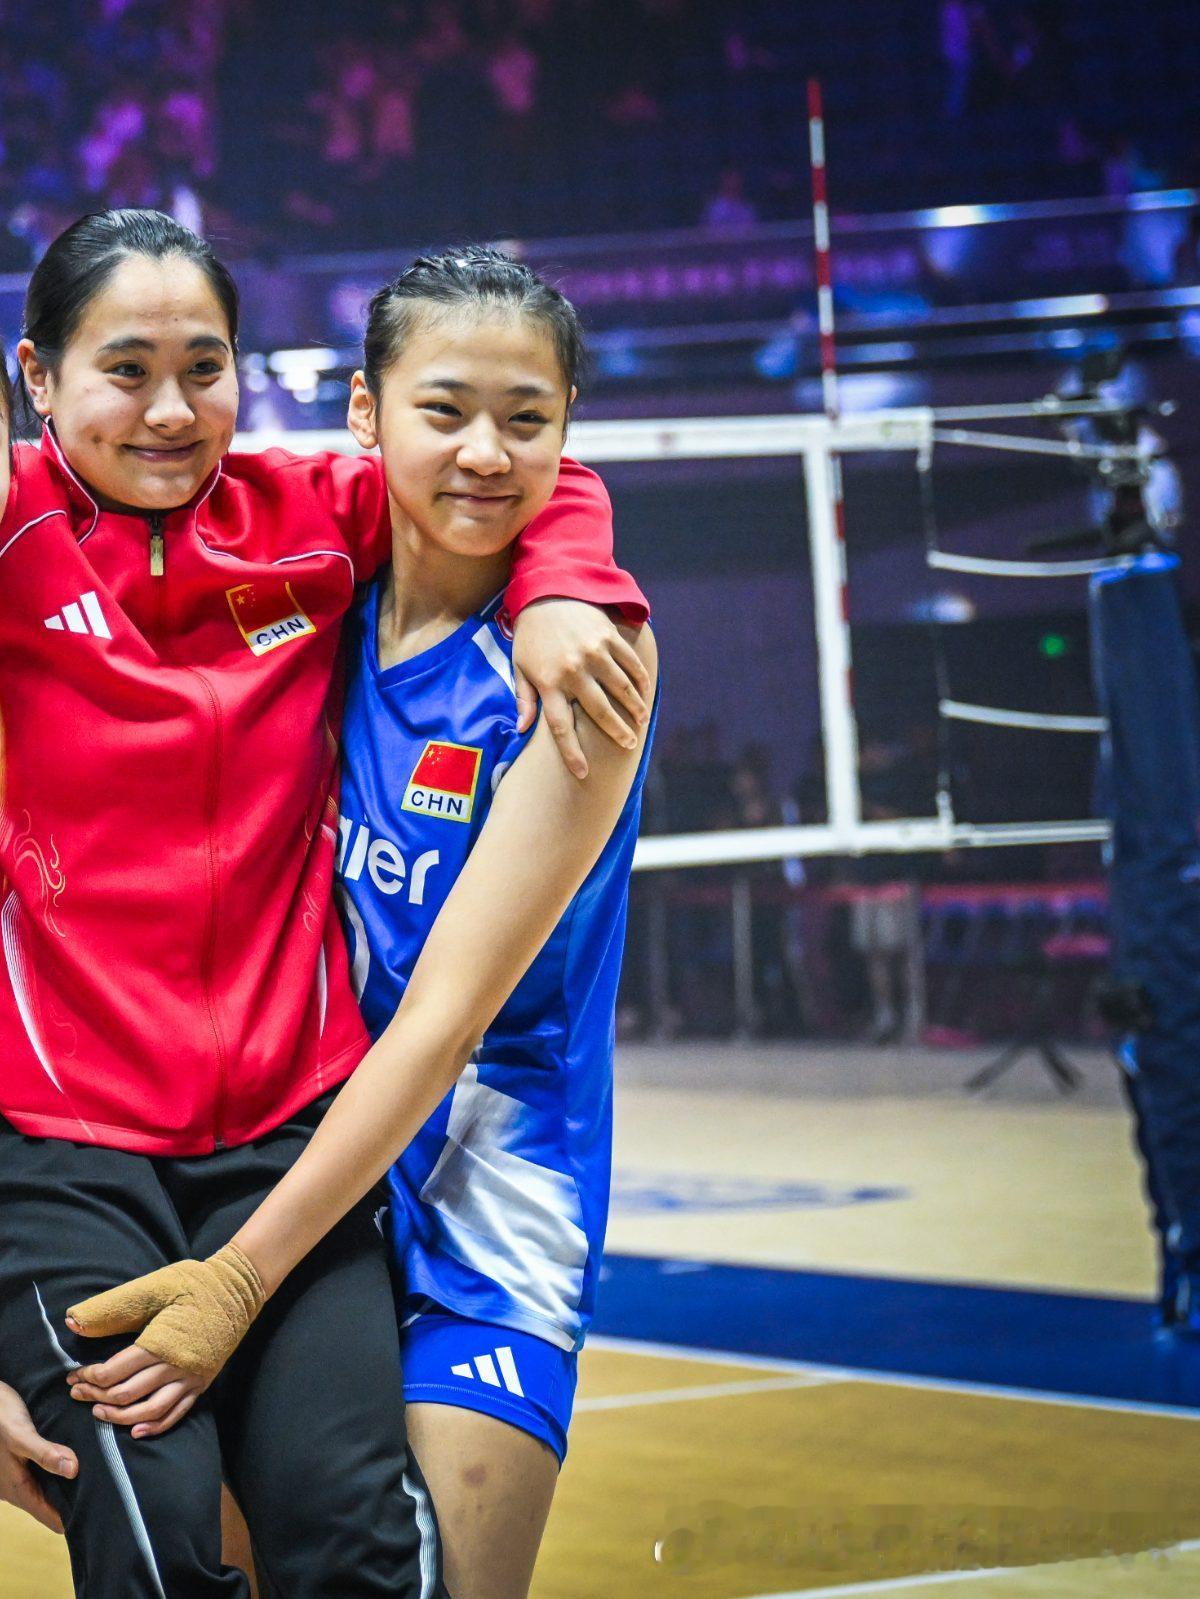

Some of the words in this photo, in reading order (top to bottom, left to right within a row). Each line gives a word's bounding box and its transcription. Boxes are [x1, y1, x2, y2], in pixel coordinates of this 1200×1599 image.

[256, 618, 305, 647] CHN
[411, 790, 463, 816] CHN
[335, 812, 440, 906] ier
